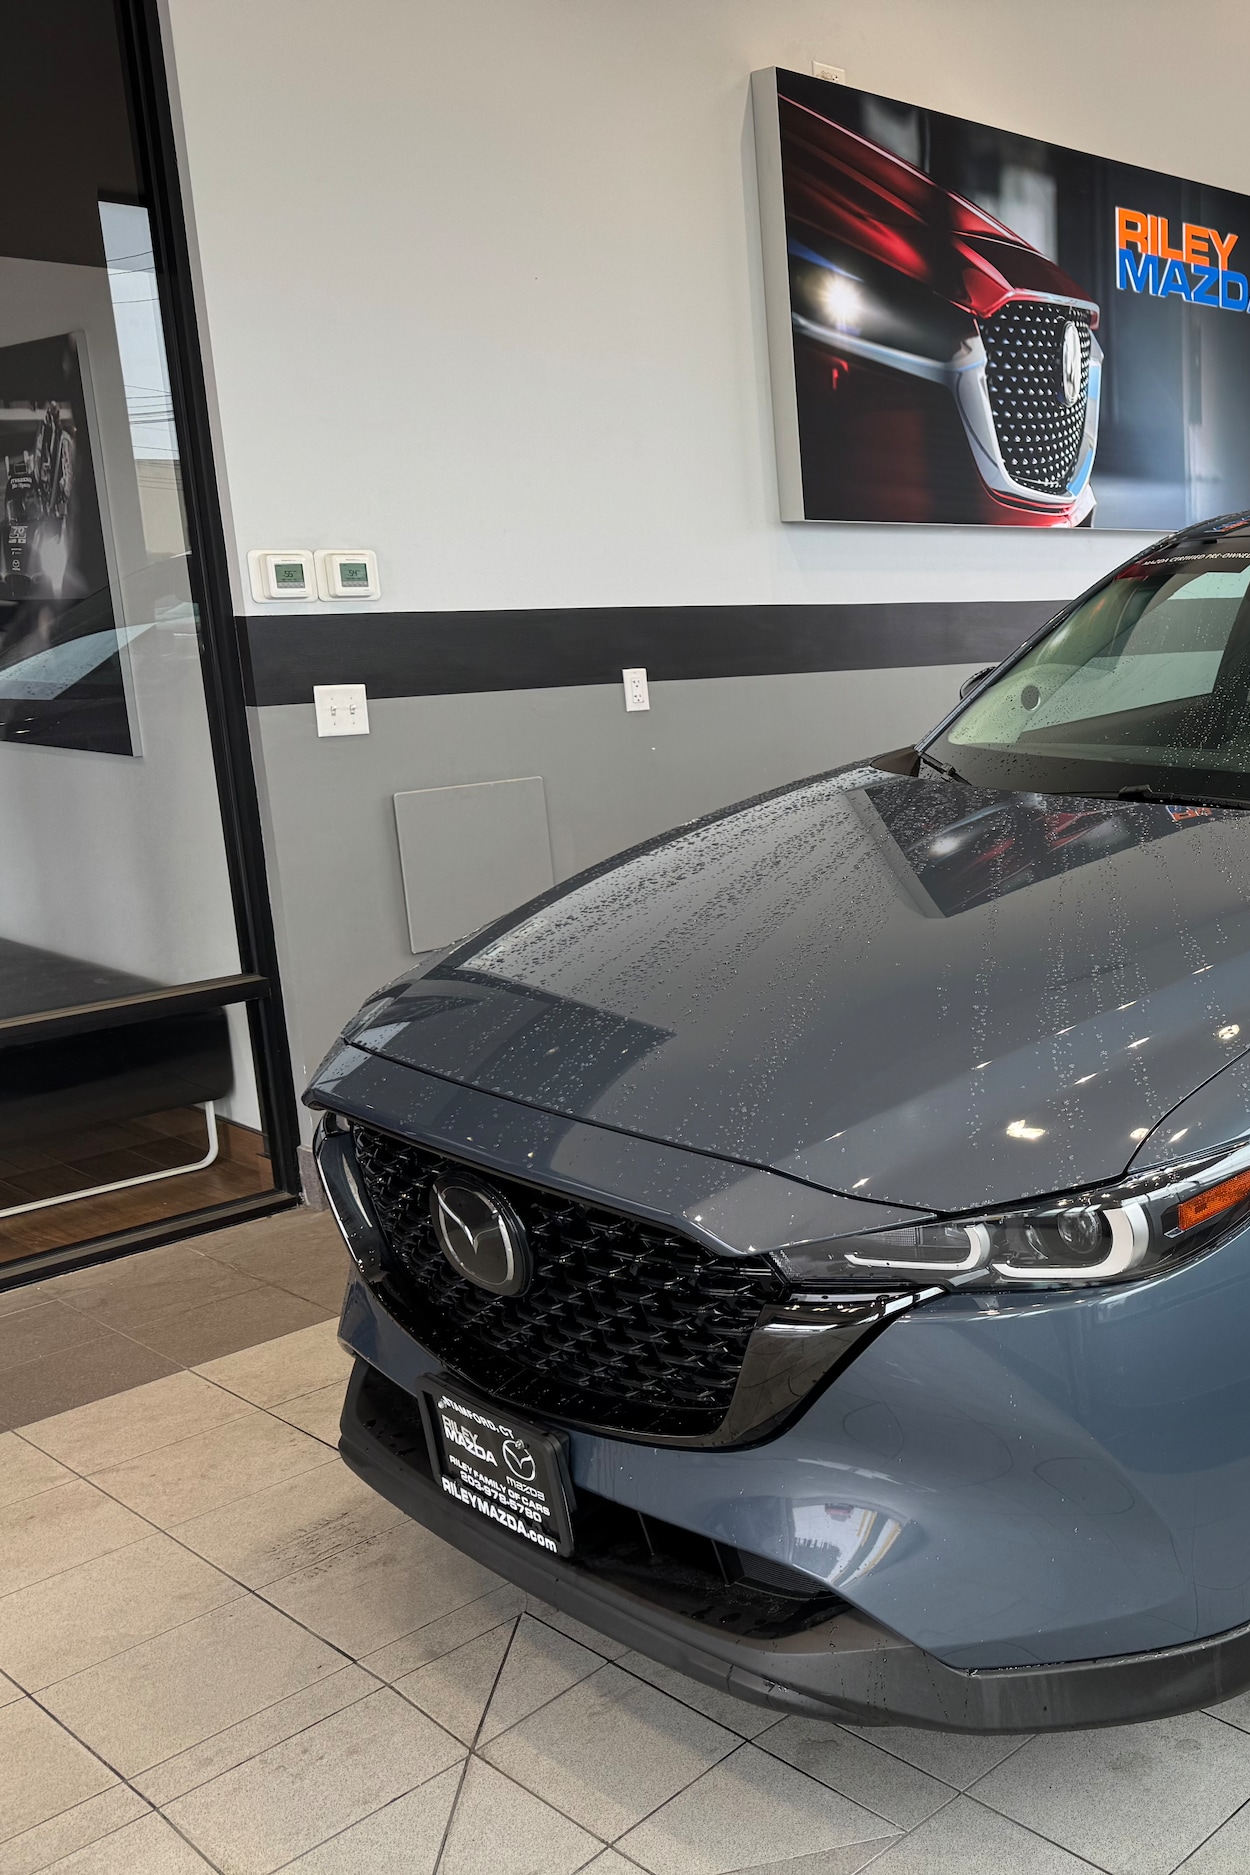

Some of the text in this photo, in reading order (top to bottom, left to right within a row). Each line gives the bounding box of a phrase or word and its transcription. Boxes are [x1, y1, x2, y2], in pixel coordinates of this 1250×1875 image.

[1115, 206, 1239, 271] RILEY
[1169, 554, 1206, 563] CERTIFIED
[441, 1414, 479, 1443] RILEY
[499, 1425, 515, 1440] CT
[444, 1426, 498, 1467] MAZDA
[449, 1455, 551, 1516] RILEY FAMILY OF CARS
[505, 1475, 546, 1502] mazda
[441, 1476, 558, 1553] RILEYMAZDA.com
